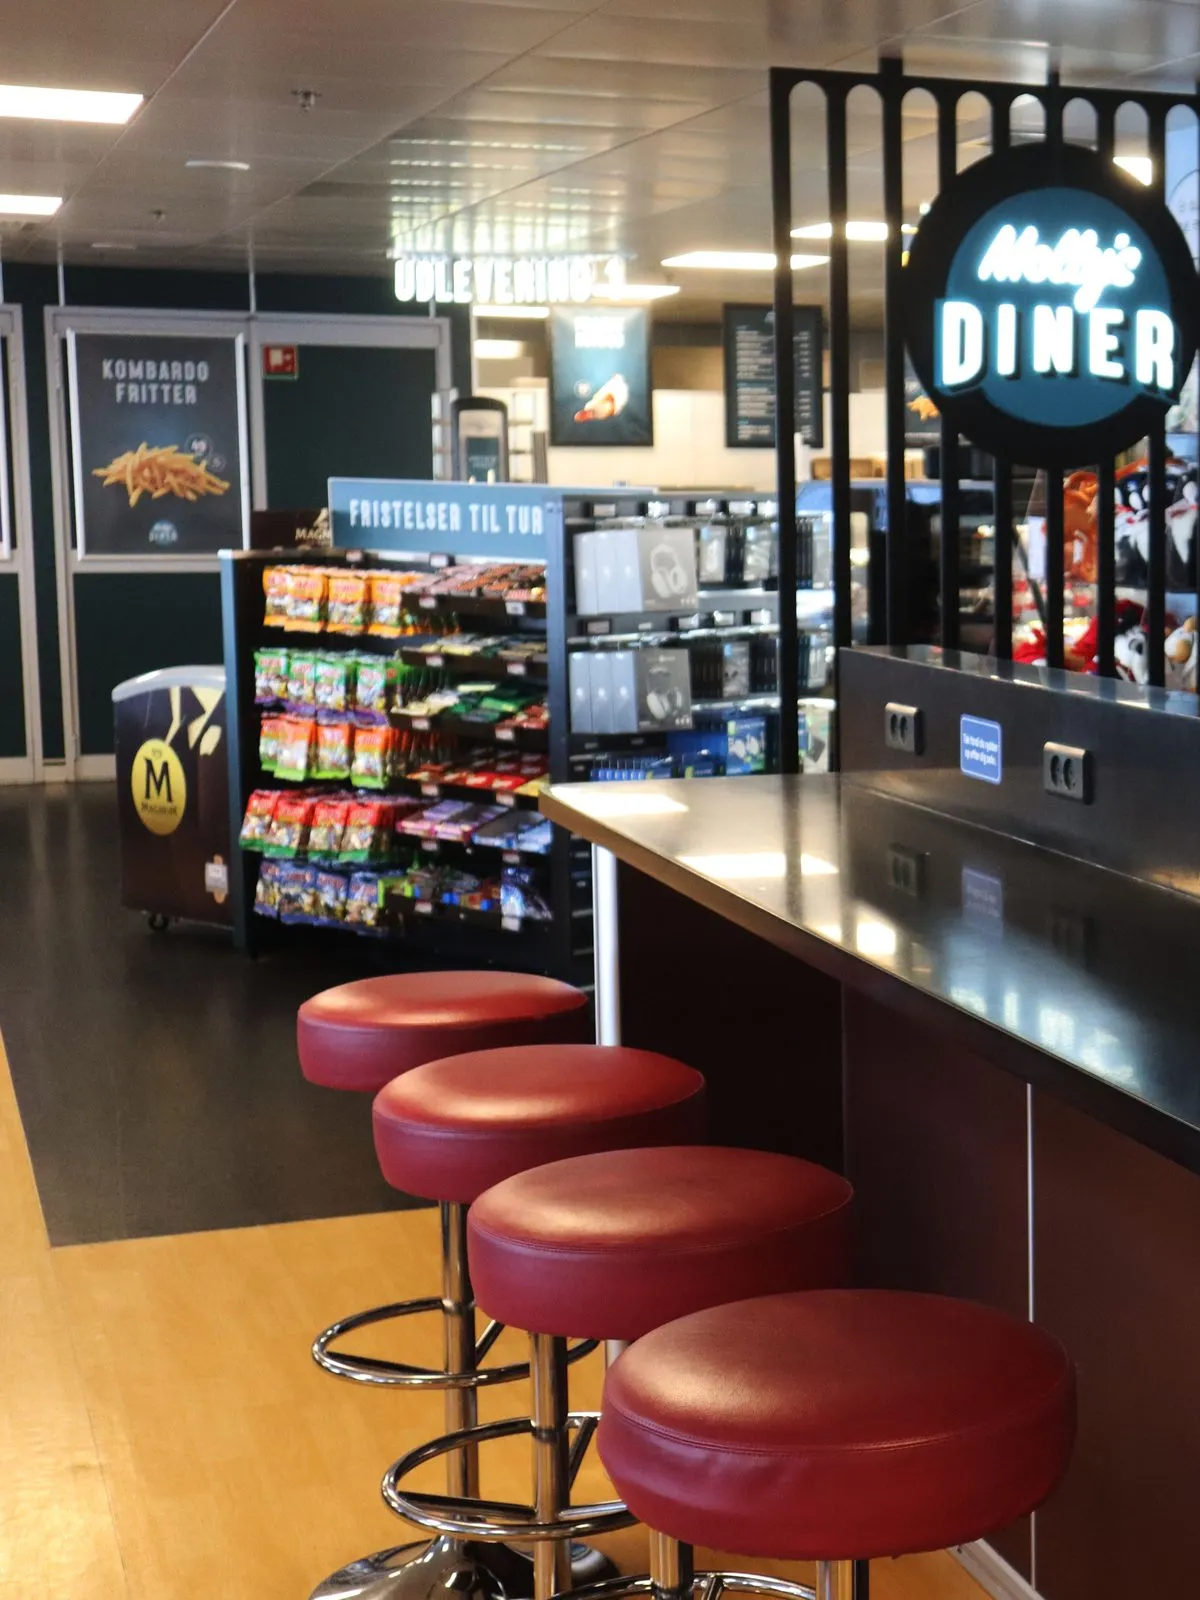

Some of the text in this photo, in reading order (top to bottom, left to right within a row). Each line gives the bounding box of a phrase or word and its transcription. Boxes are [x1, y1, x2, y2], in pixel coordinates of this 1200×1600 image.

[394, 258, 593, 304] UDLEVERING
[977, 224, 1143, 313] Molly's
[942, 300, 1175, 391] DINER
[102, 358, 210, 382] KOMBARDO
[115, 383, 198, 404] FRITTER
[295, 527, 332, 541] MAGN
[349, 499, 544, 536] FRISTELSER TIL TUR
[145, 756, 172, 803] M
